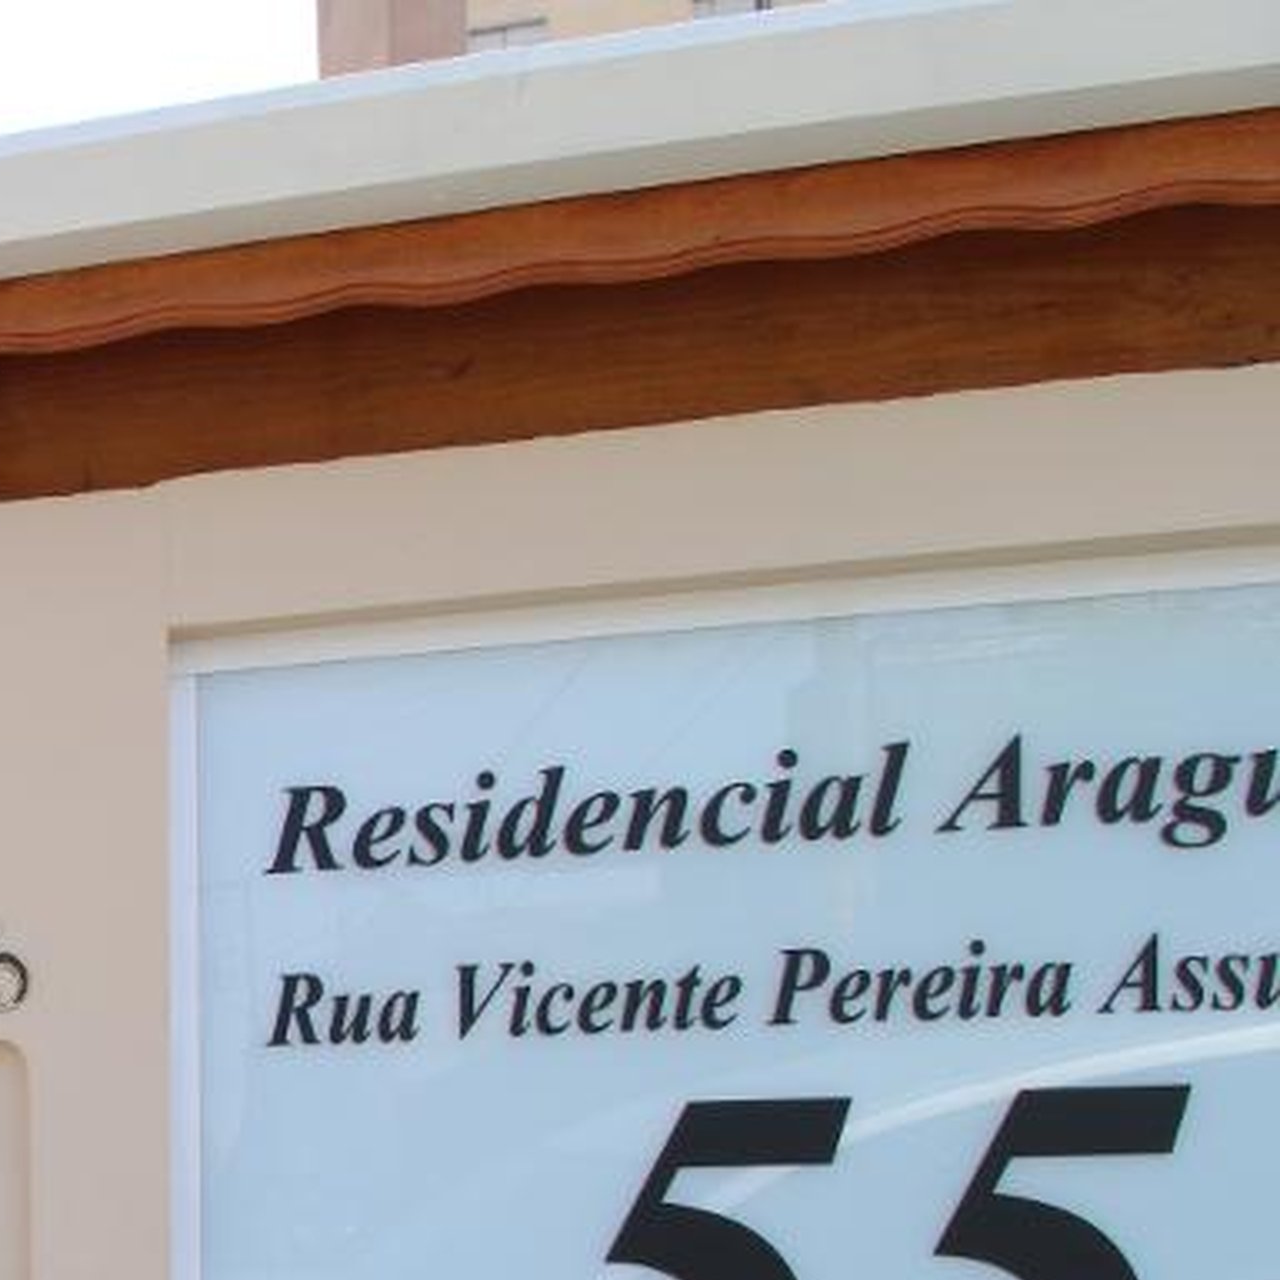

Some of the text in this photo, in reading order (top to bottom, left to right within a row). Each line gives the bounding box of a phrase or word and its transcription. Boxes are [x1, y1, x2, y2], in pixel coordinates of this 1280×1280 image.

[265, 741, 910, 875] Residencial
[266, 973, 420, 1048] Rua
[457, 960, 743, 1040] Vicente
[767, 939, 1073, 1027] Pereira
